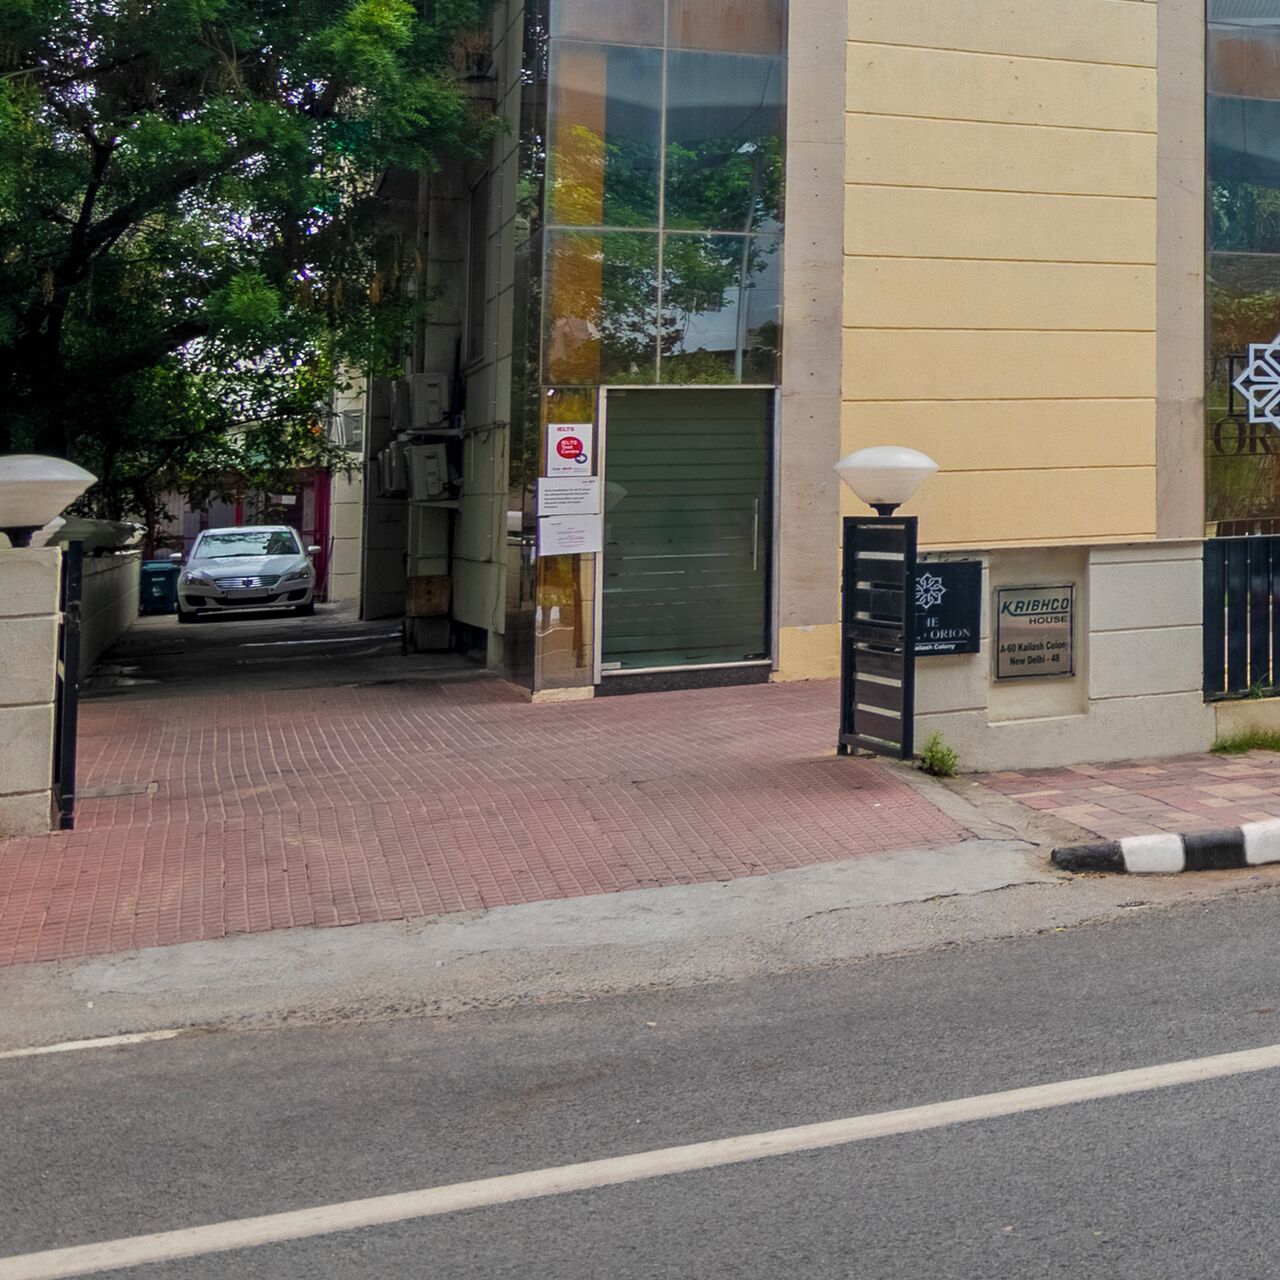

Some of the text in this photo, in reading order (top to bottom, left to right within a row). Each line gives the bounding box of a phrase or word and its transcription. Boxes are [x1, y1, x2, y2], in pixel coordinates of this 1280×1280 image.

[1001, 598, 1070, 616] KRIBHCO
[1029, 615, 1067, 625] HOUSE
[930, 628, 971, 640] ORION
[1018, 642, 1045, 652] Kailash
[1010, 655, 1026, 666] New
[1027, 654, 1045, 665] Delhi
